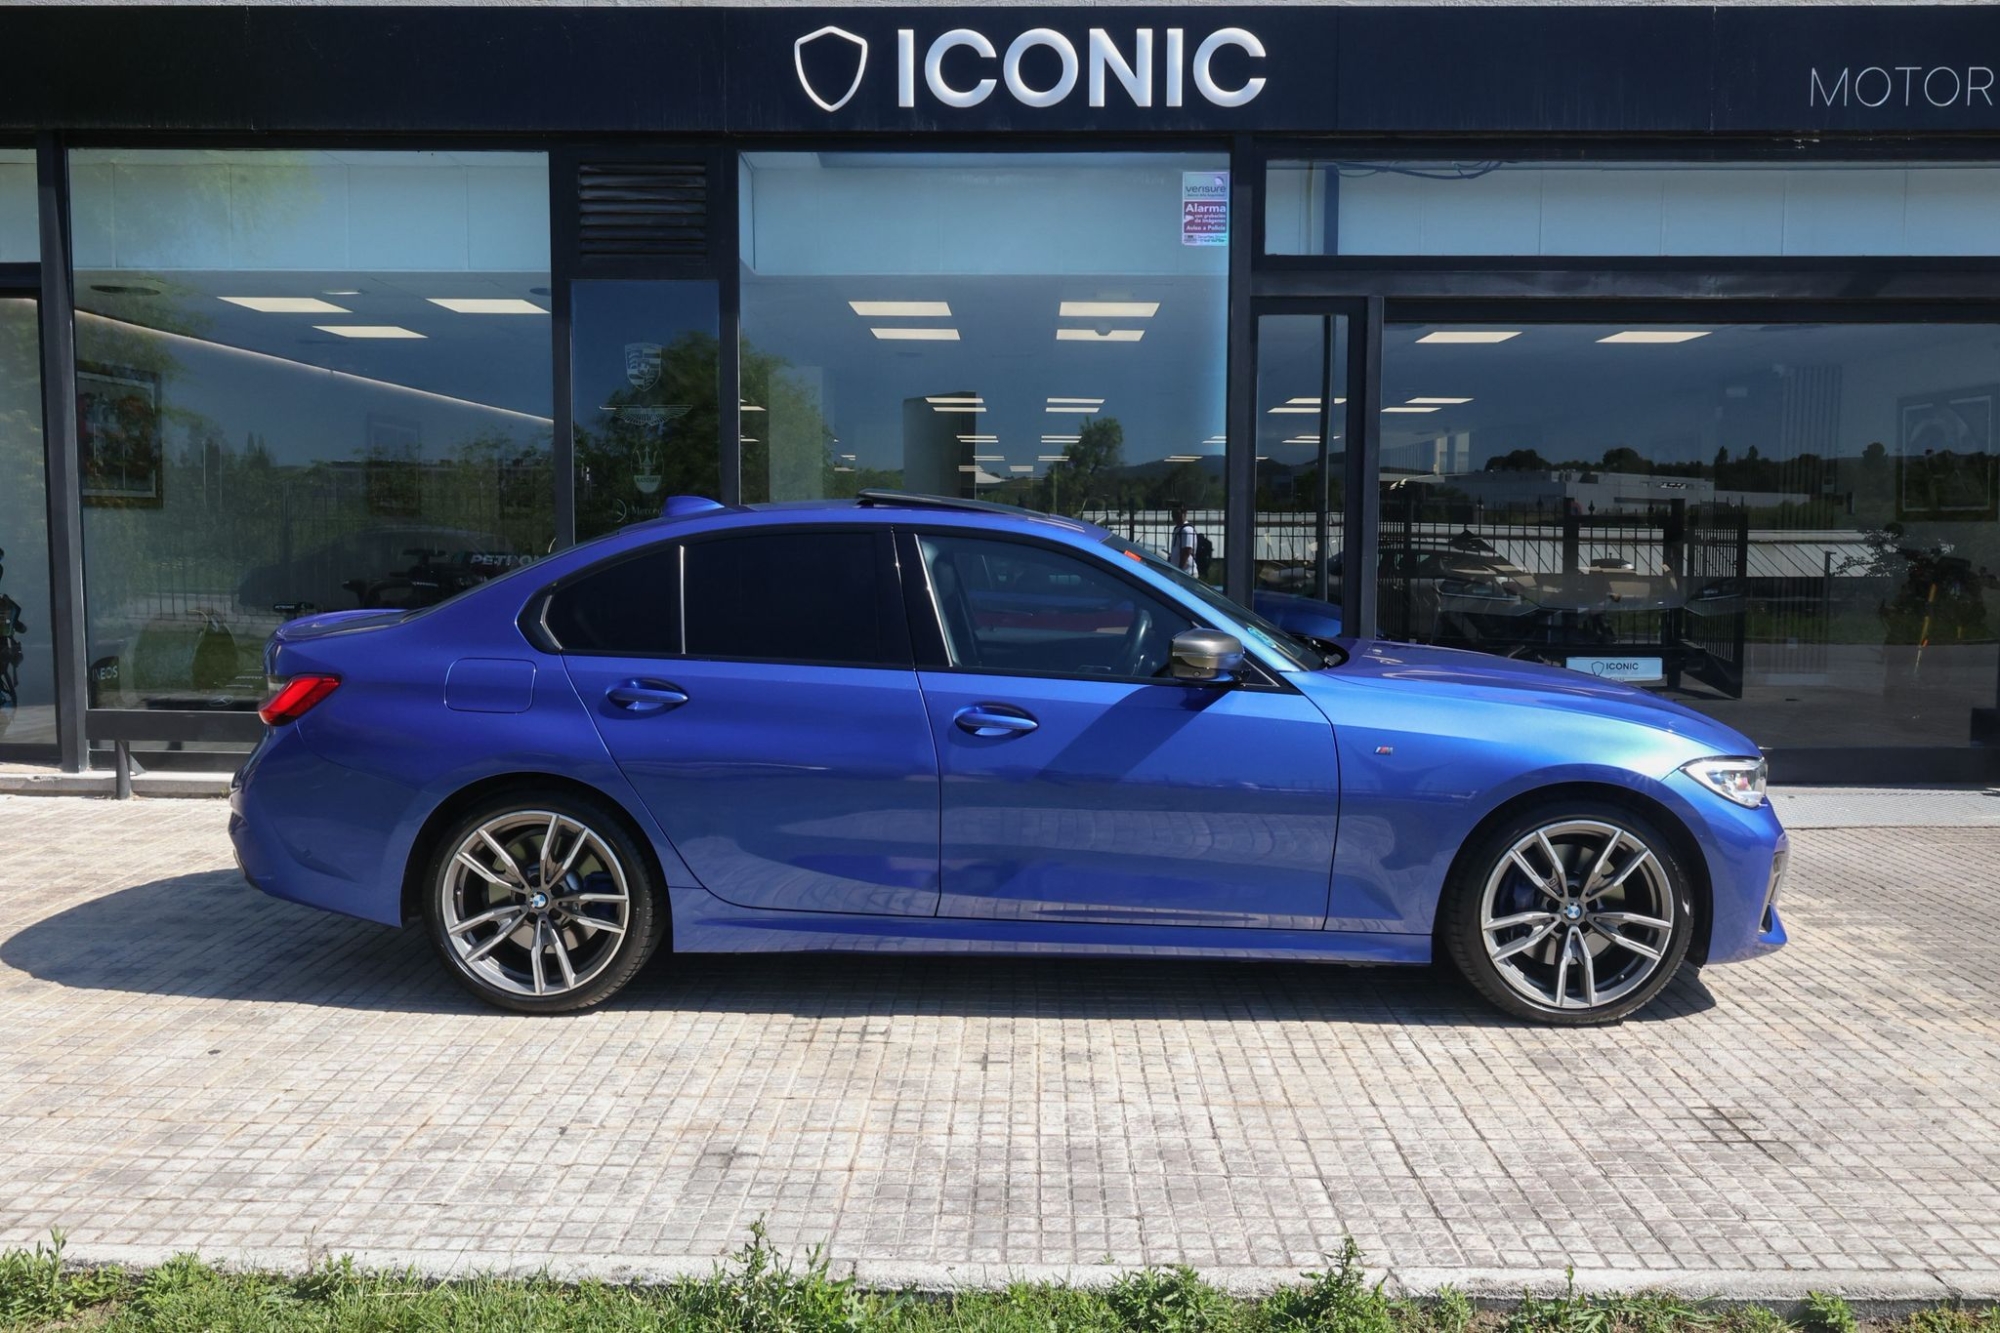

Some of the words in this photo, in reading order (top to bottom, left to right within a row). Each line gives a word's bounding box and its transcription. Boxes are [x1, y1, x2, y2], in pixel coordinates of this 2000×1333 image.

[898, 27, 1267, 108] ICONIC
[1810, 66, 1995, 107] MOTOR
[1185, 185, 1227, 193] verisure
[1185, 203, 1226, 213] Alarma
[1605, 662, 1640, 671] ICONIC
